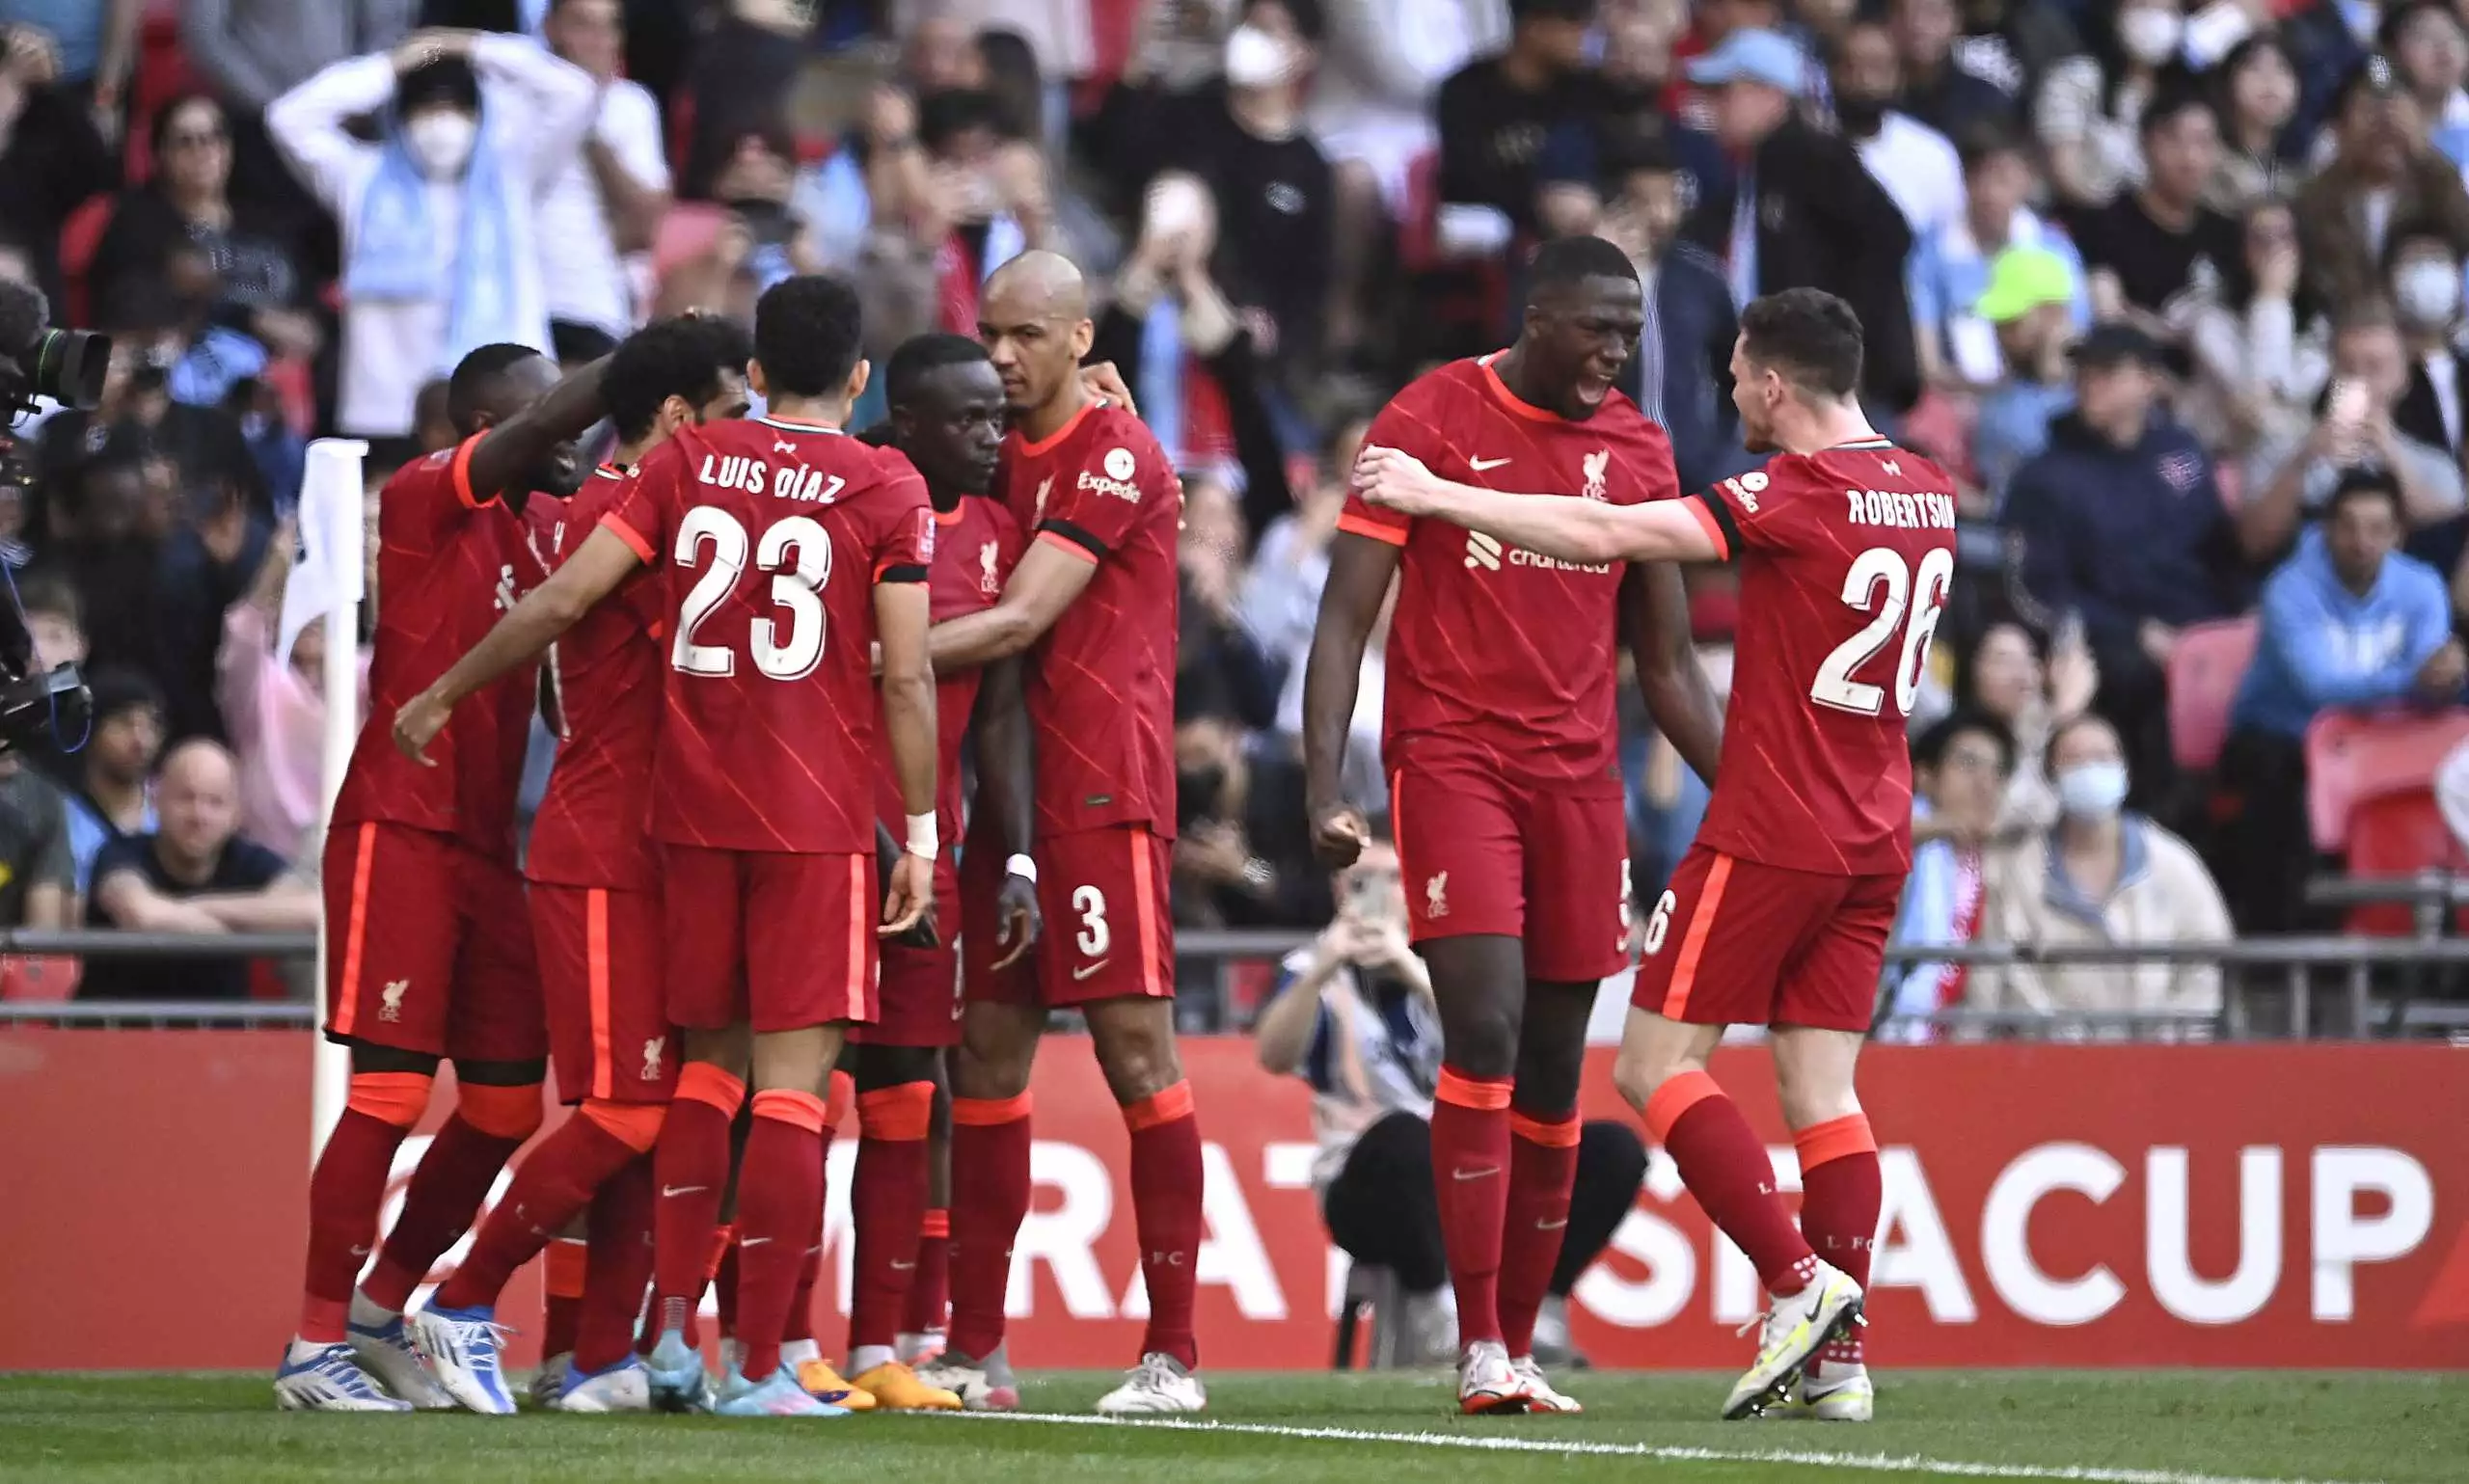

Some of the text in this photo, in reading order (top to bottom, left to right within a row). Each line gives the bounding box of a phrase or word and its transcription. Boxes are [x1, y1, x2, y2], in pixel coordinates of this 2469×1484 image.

[698, 454, 846, 504] LUIS DÍAZ
[671, 504, 833, 681] 23
[1809, 547, 1954, 716] 26
[1072, 884, 1110, 957] 3
